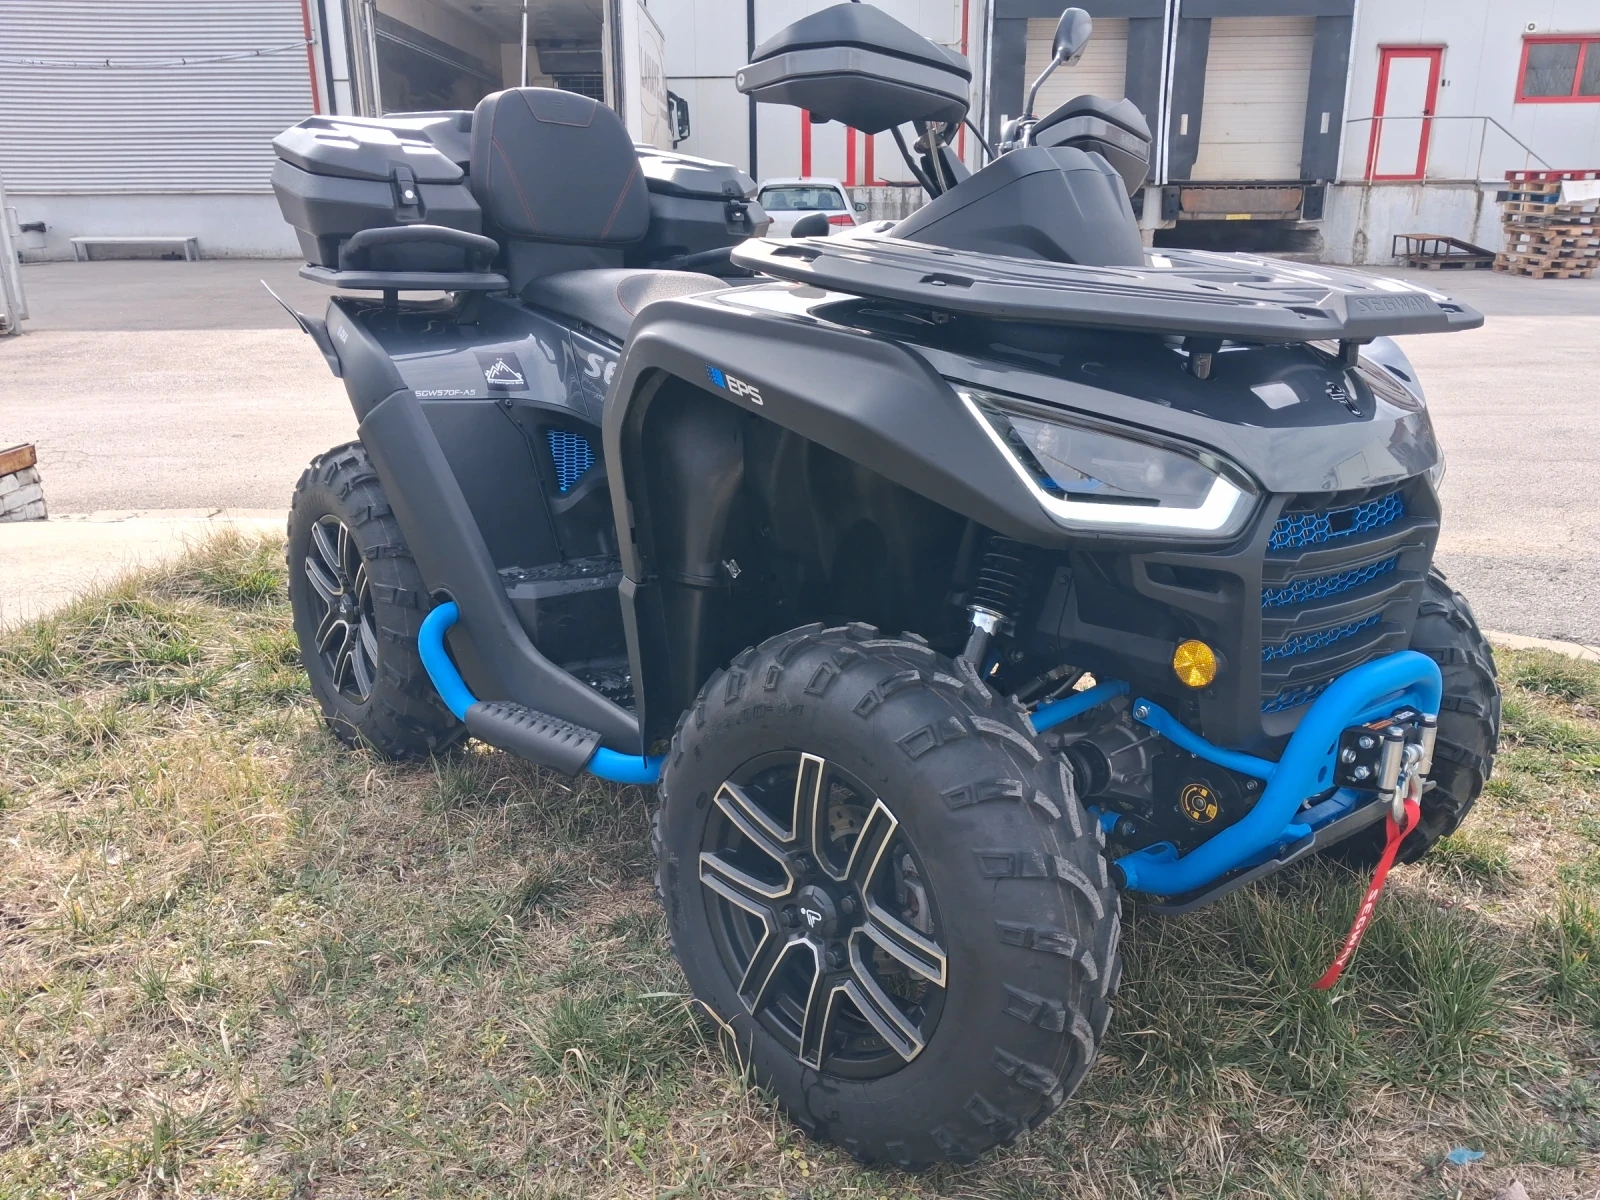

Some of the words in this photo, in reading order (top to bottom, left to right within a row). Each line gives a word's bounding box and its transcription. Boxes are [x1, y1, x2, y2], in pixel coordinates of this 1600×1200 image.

[1355, 295, 1430, 313] SEGWAY
[725, 374, 764, 406] EPS
[1336, 888, 1379, 967] SEGWAY
